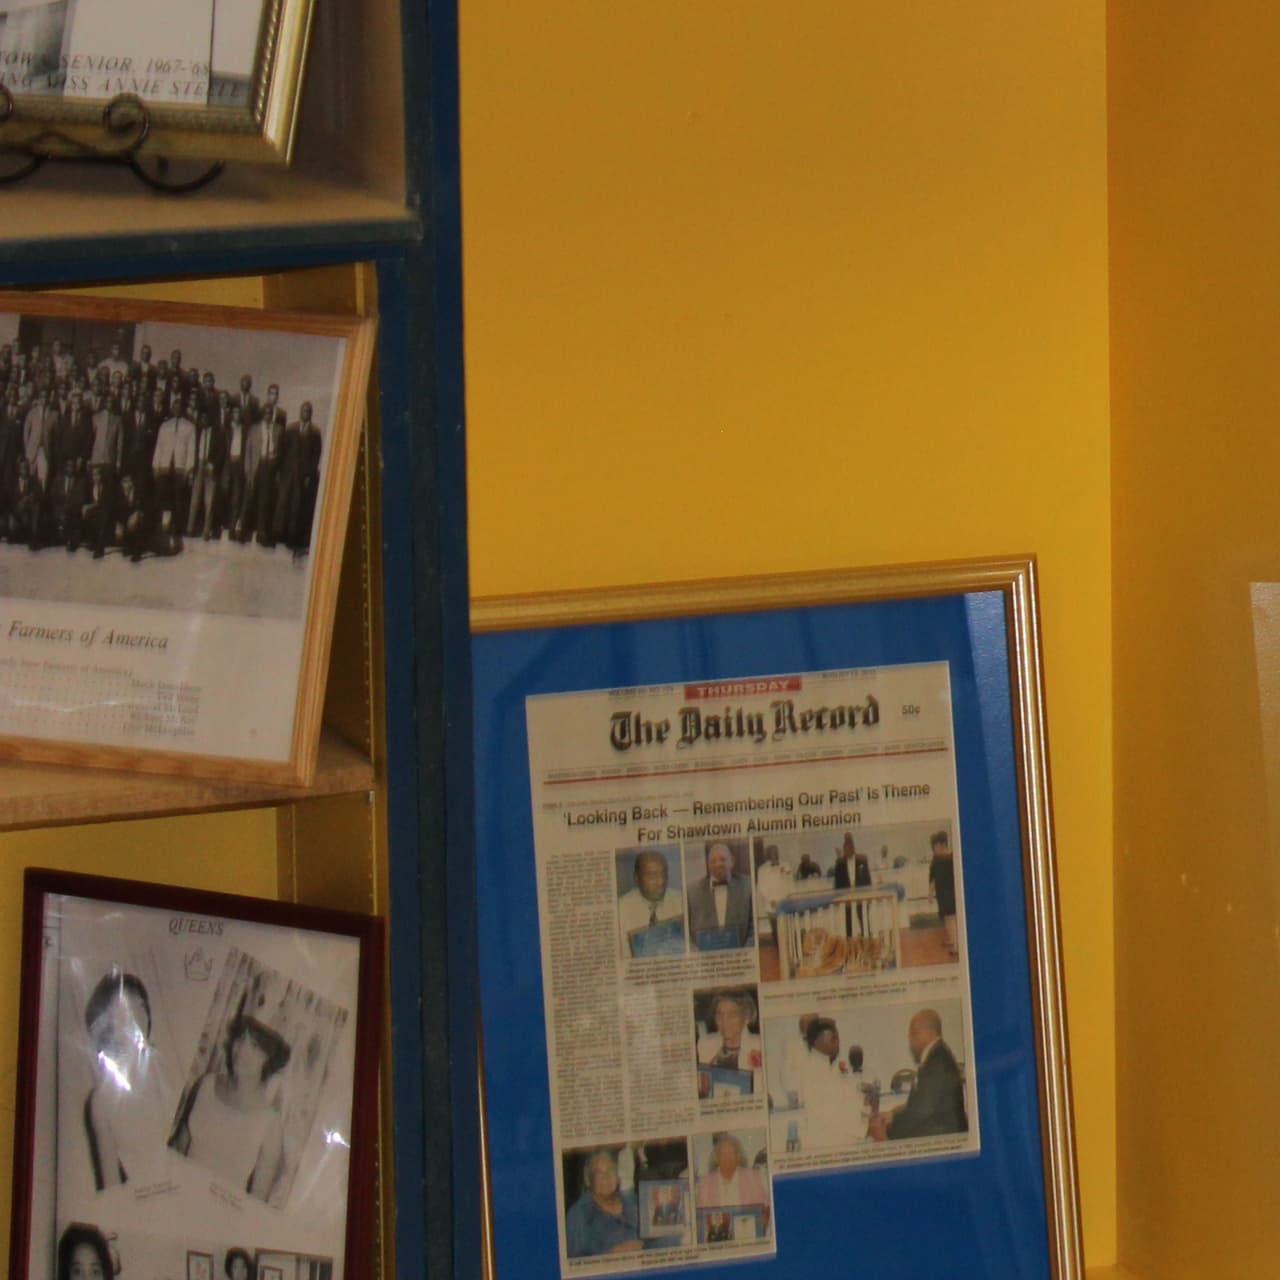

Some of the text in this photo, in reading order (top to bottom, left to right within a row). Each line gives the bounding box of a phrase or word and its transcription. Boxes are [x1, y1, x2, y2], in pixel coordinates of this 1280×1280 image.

[8, 620, 169, 650] Farmers of America
[698, 679, 790, 697] THURSDAY
[610, 694, 880, 750] The Daily Record
[632, 803, 668, 820] Back
[692, 794, 793, 816] Remembering
[798, 792, 824, 806] Our
[882, 782, 930, 799] Theme
[637, 809, 861, 843] For Shawtown Alumni Reunion
[168, 918, 225, 936] QUEENS
